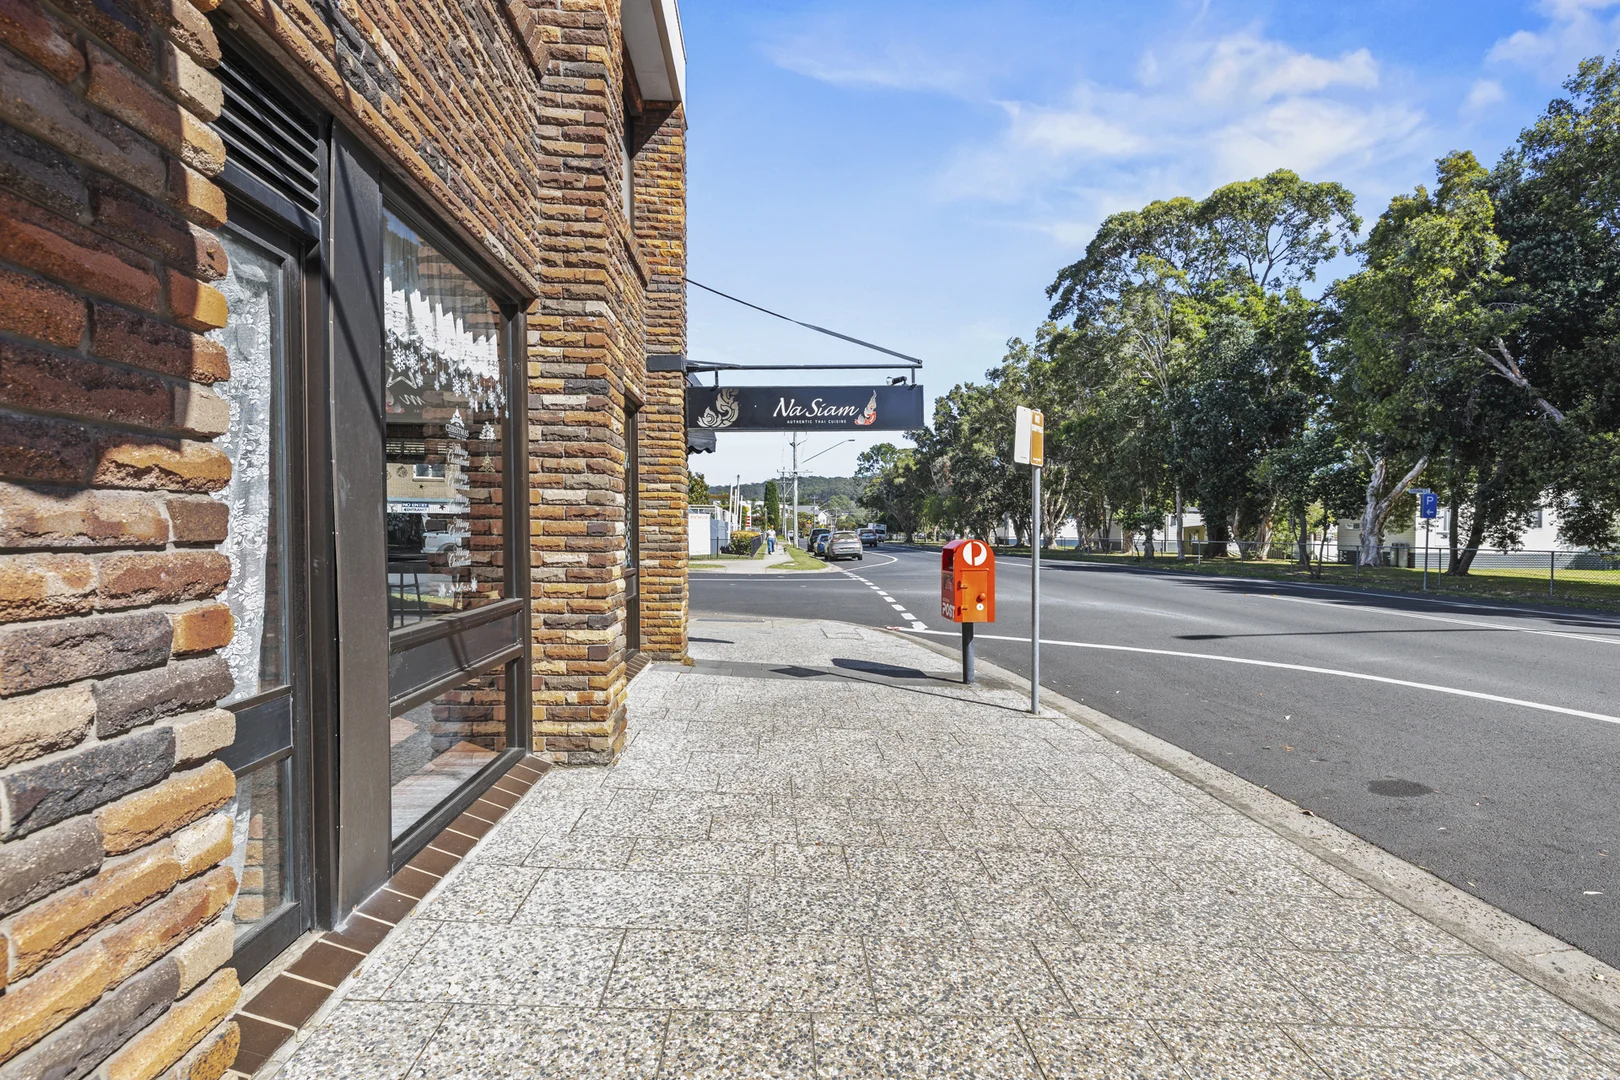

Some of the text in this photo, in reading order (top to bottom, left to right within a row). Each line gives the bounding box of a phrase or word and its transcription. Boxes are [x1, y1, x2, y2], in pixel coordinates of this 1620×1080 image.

[773, 397, 860, 417] Na Siam
[445, 423, 470, 437] CHRISTMAS
[1426, 496, 1434, 505] P
[942, 602, 955, 618] POST
